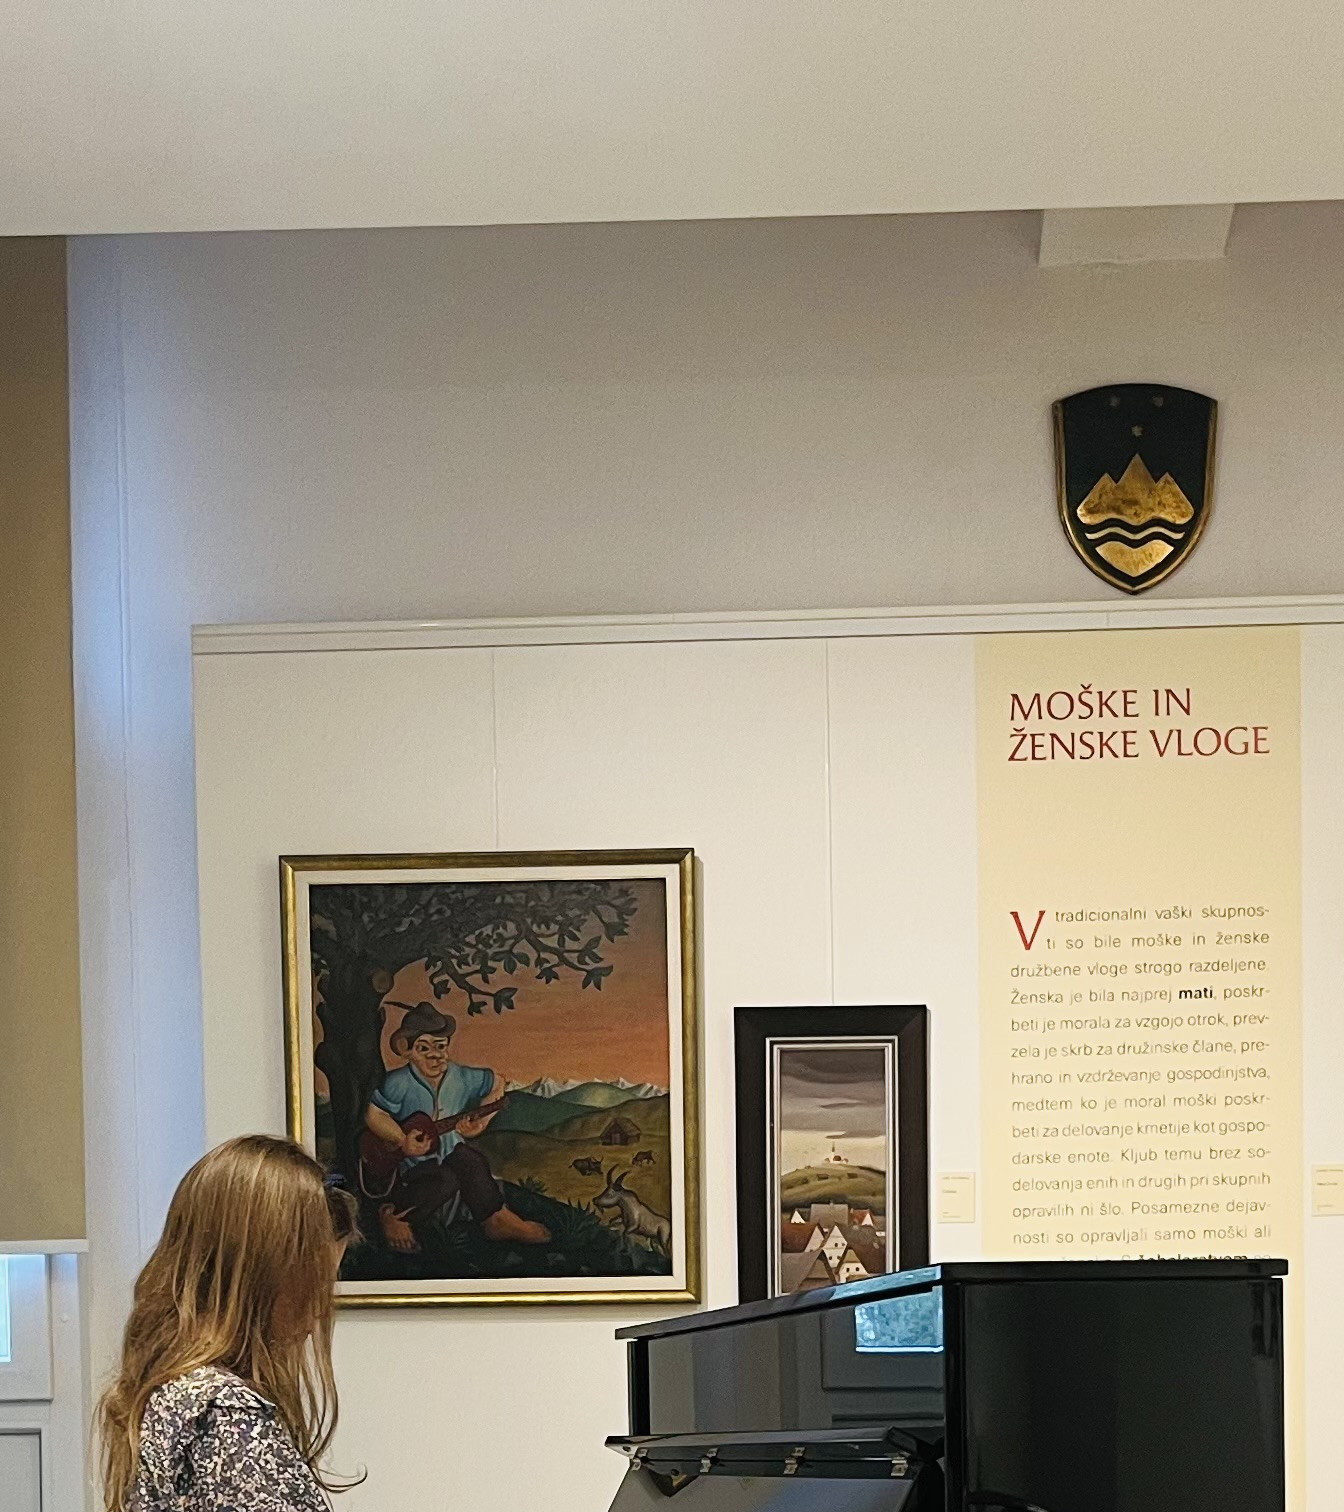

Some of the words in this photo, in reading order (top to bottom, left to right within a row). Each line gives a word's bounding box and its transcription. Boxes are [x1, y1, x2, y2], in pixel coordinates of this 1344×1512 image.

[1010, 683, 1139, 721] MOŠKE
[1153, 688, 1190, 716] IN
[1008, 727, 1139, 761] ŽENSKE
[1149, 726, 1270, 757] VLOGE
[1010, 910, 1046, 950] V
[1056, 907, 1146, 922] tradicionalni
[1155, 905, 1192, 919] vaški
[1201, 904, 1269, 920] skupnos-
[1047, 937, 1055, 949] ti
[1066, 938, 1083, 949] so
[1094, 934, 1121, 948] bile
[1132, 932, 1182, 947] moške
[1193, 934, 1205, 945] in
[1216, 930, 1269, 945] ženske
[1011, 963, 1081, 977] družbene
[1087, 961, 1127, 978] vloge
[1135, 961, 1182, 976] strogo
[1011, 987, 1063, 1004] Ženska
[1069, 992, 1082, 1005] je
[1089, 988, 1114, 1002] bila
[1122, 989, 1172, 1003] najprej
[1224, 984, 1270, 1001] poskr-
[1012, 1017, 1038, 1031] beti
[1042, 1019, 1055, 1033] je
[1060, 1015, 1110, 1029] morala
[1115, 1017, 1131, 1028] za
[1135, 1016, 1183, 1030] vzgojo
[1234, 1013, 1269, 1027] prev-
[1011, 1045, 1040, 1058] zela
[1044, 1046, 1057, 1060] je
[1061, 1043, 1092, 1057] skrb
[1096, 1045, 1112, 1055] za
[1117, 1040, 1188, 1055] družinske
[1241, 1040, 1270, 1054] pre-
[1012, 1071, 1052, 1084] hrano
[1059, 1073, 1071, 1083] in
[1077, 1068, 1161, 1084] vzdrževanje
[1012, 1097, 1072, 1111] medtem
[1081, 1095, 1097, 1109] ko
[1104, 1098, 1116, 1112] je
[1125, 1093, 1166, 1108] moral
[1173, 1093, 1216, 1107] moški
[1225, 1091, 1270, 1108] poskr-
[1012, 1125, 1039, 1138] beti
[1042, 1126, 1058, 1137] za
[1062, 1123, 1133, 1138] delovanje
[1137, 1121, 1190, 1136] kmetije
[1194, 1119, 1216, 1133] kot
[1219, 1121, 1270, 1135] gospo-
[1012, 1150, 1061, 1165] darske
[1121, 1147, 1157, 1165] Kljub
[1165, 1149, 1201, 1160] temu
[1210, 1145, 1240, 1159] brez
[1248, 1147, 1271, 1158] so-
[1013, 1177, 1082, 1193] delovanja
[1086, 1175, 1118, 1189] enih
[1122, 1177, 1134, 1188] in
[1138, 1173, 1186, 1190] drugih
[1190, 1175, 1208, 1189] pri
[1213, 1171, 1270, 1187] skupnih
[1013, 1203, 1074, 1220] opravilih
[1081, 1205, 1093, 1215] ni
[1132, 1201, 1219, 1214] Posamezne
[1226, 1198, 1271, 1215] dejav-
[1013, 1232, 1049, 1244] nosti
[1056, 1232, 1073, 1243] so
[1081, 1227, 1147, 1245] opravljali
[1154, 1229, 1196, 1240] samo
[1203, 1225, 1247, 1239] moški
[1254, 1224, 1271, 1238] ali
